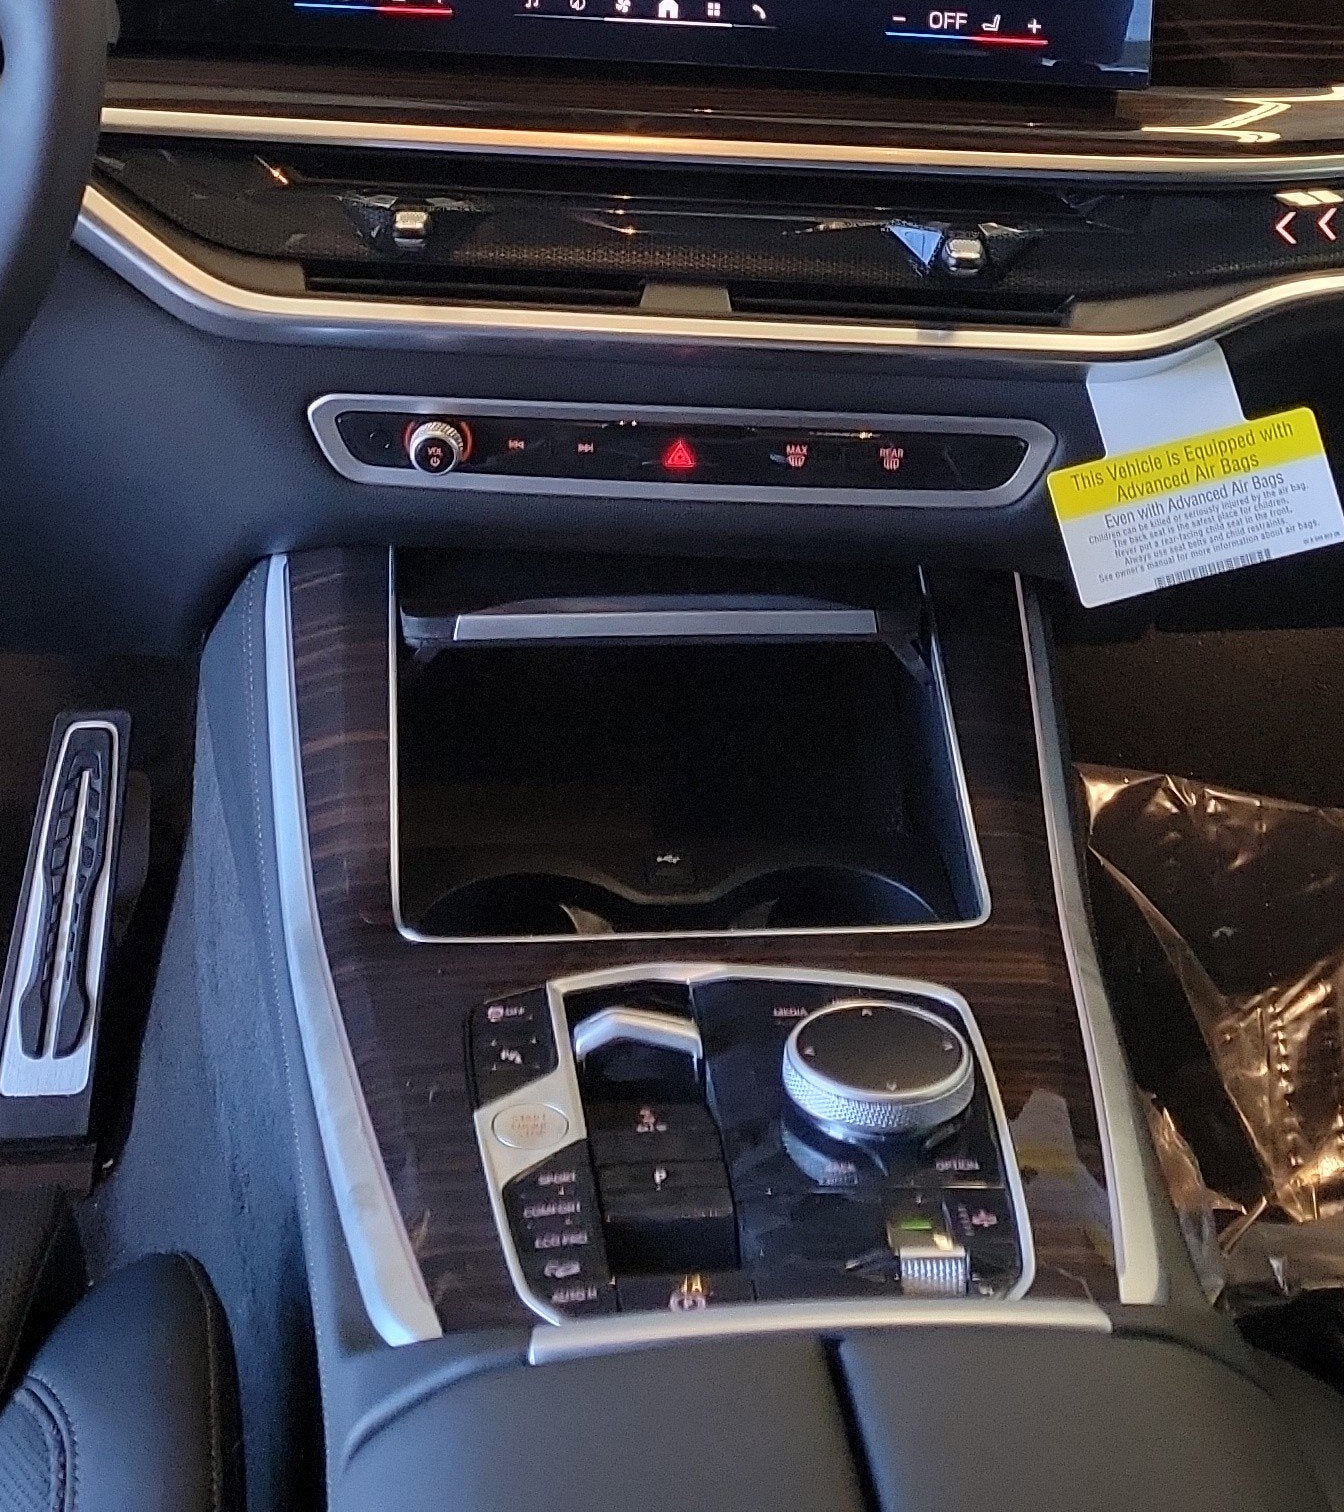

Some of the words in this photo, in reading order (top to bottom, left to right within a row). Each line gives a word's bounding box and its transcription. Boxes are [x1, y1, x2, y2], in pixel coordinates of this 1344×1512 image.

[928, 11, 968, 30] OFF
[427, 446, 443, 456] VOL
[786, 444, 808, 455] MAX
[879, 447, 904, 459] REAR
[1070, 470, 1104, 491] This
[1106, 455, 1163, 481] Vehicle
[1165, 450, 1181, 467] is
[1184, 429, 1255, 462] Equipped
[1259, 421, 1294, 442] with
[1117, 468, 1190, 502] Advanced
[1195, 462, 1215, 482] Air
[1220, 454, 1259, 475] Bags
[1104, 511, 1136, 529] Even
[1137, 501, 1165, 520] with
[1168, 484, 1228, 513] Advanced
[1232, 479, 1249, 497] Air
[1251, 473, 1284, 490] Bags
[773, 1006, 808, 1018] MEDIA
[935, 1159, 980, 1171] OPTION
[537, 1171, 576, 1187] SPORT
[523, 1201, 581, 1219] COMFORT
